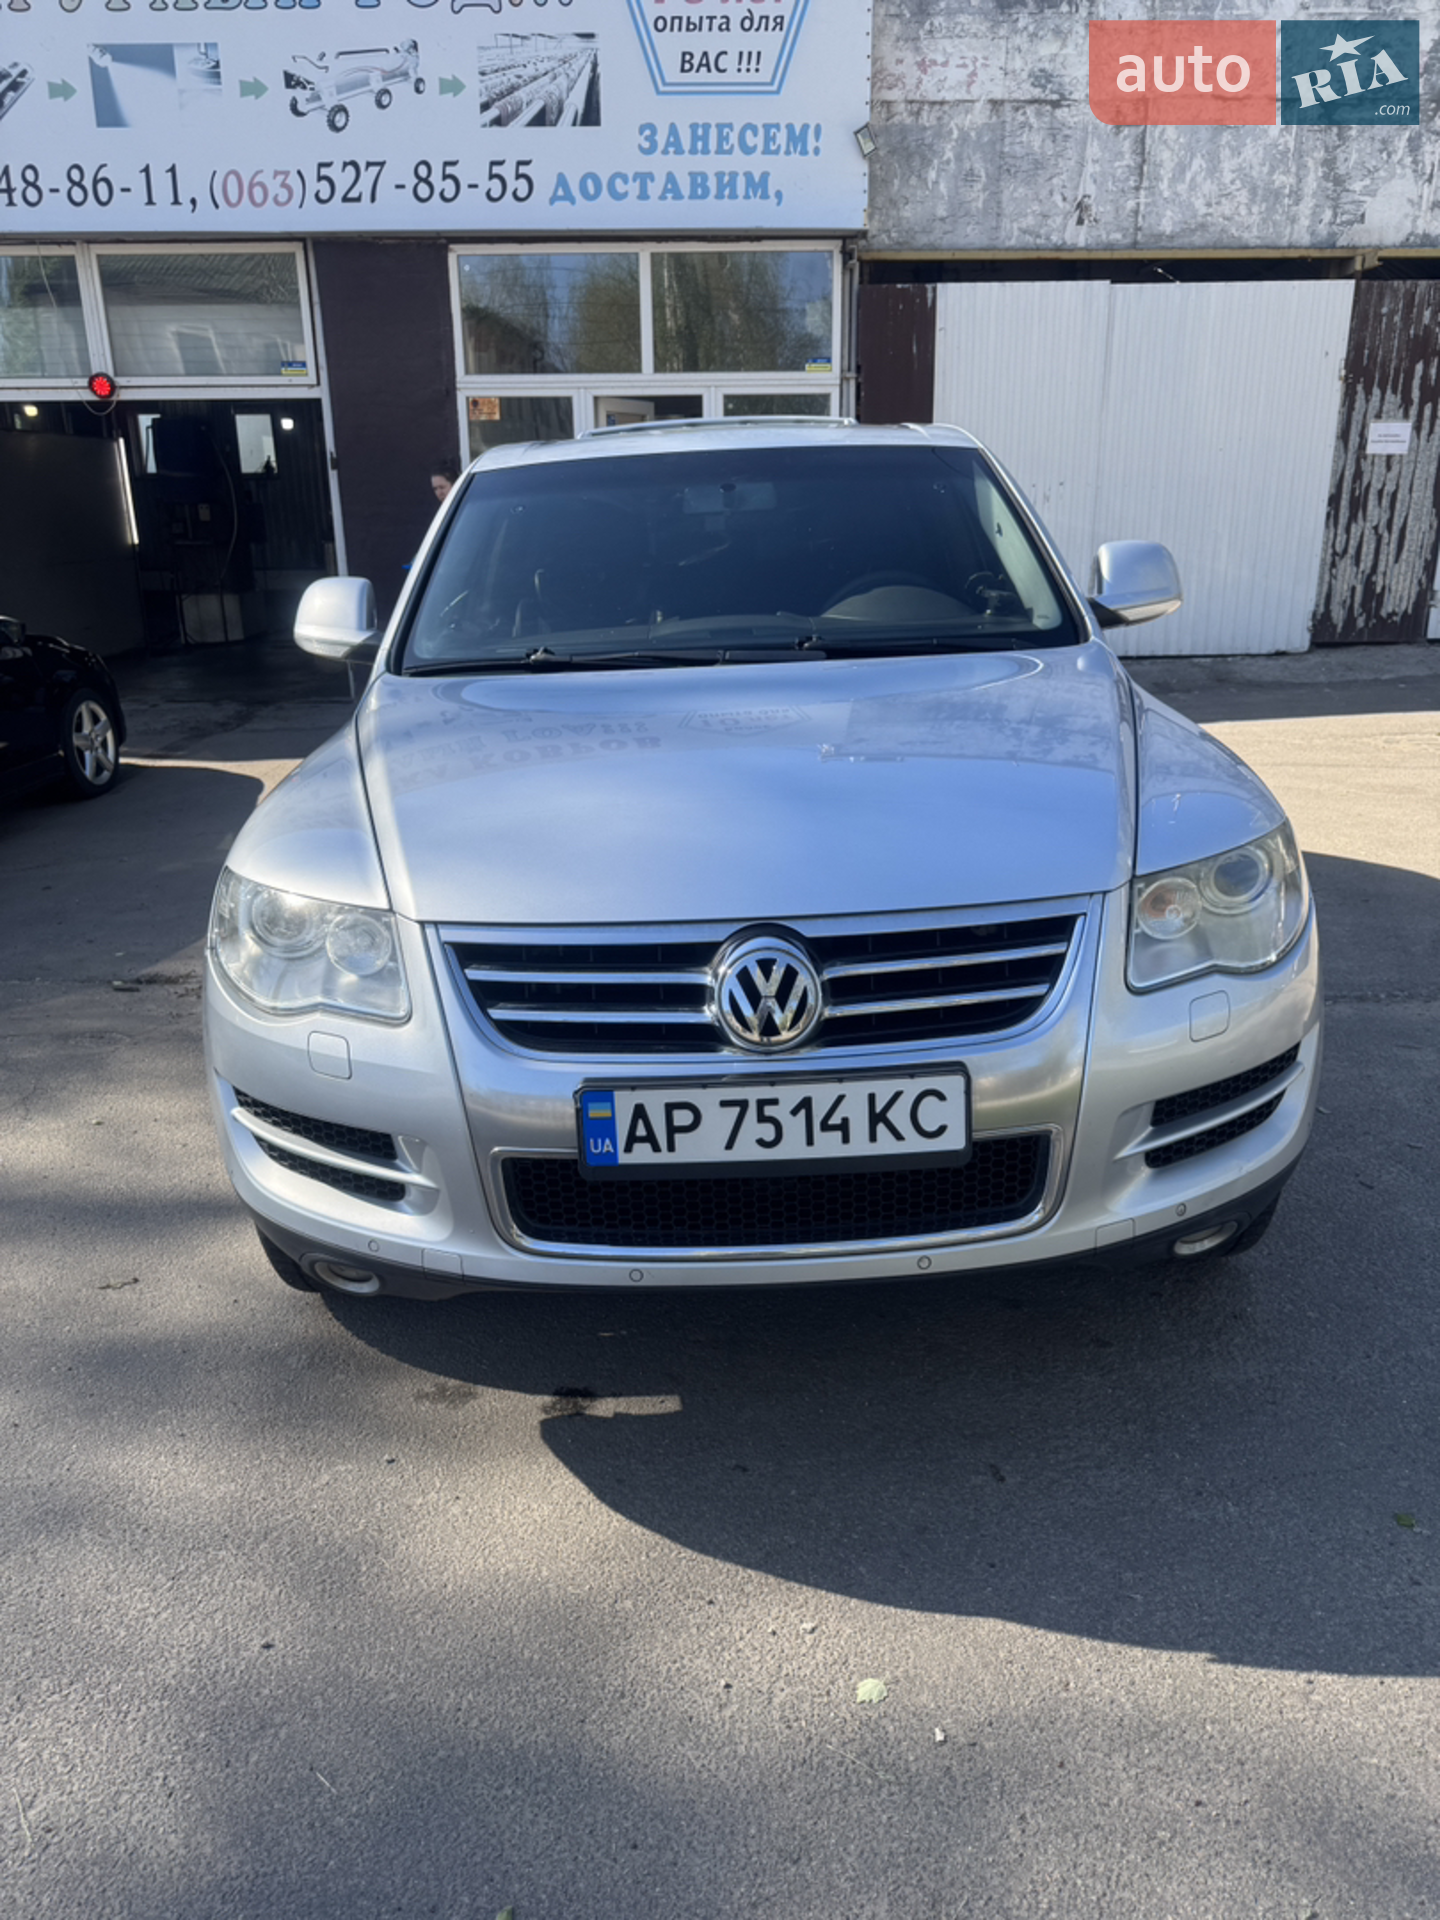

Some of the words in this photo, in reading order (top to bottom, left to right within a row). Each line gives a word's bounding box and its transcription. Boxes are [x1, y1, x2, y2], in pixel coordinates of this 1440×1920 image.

[653, 14, 731, 33] опыта
[739, 8, 785, 33] для
[679, 50, 728, 74] ВАС
[637, 122, 822, 156] ЗАНЕСЕМ!
[548, 171, 784, 206] ДОСТАВИМ,
[623, 1100, 703, 1154] AP
[719, 1093, 851, 1151] 7514
[867, 1088, 949, 1144] KC
[589, 1137, 615, 1155] UA
